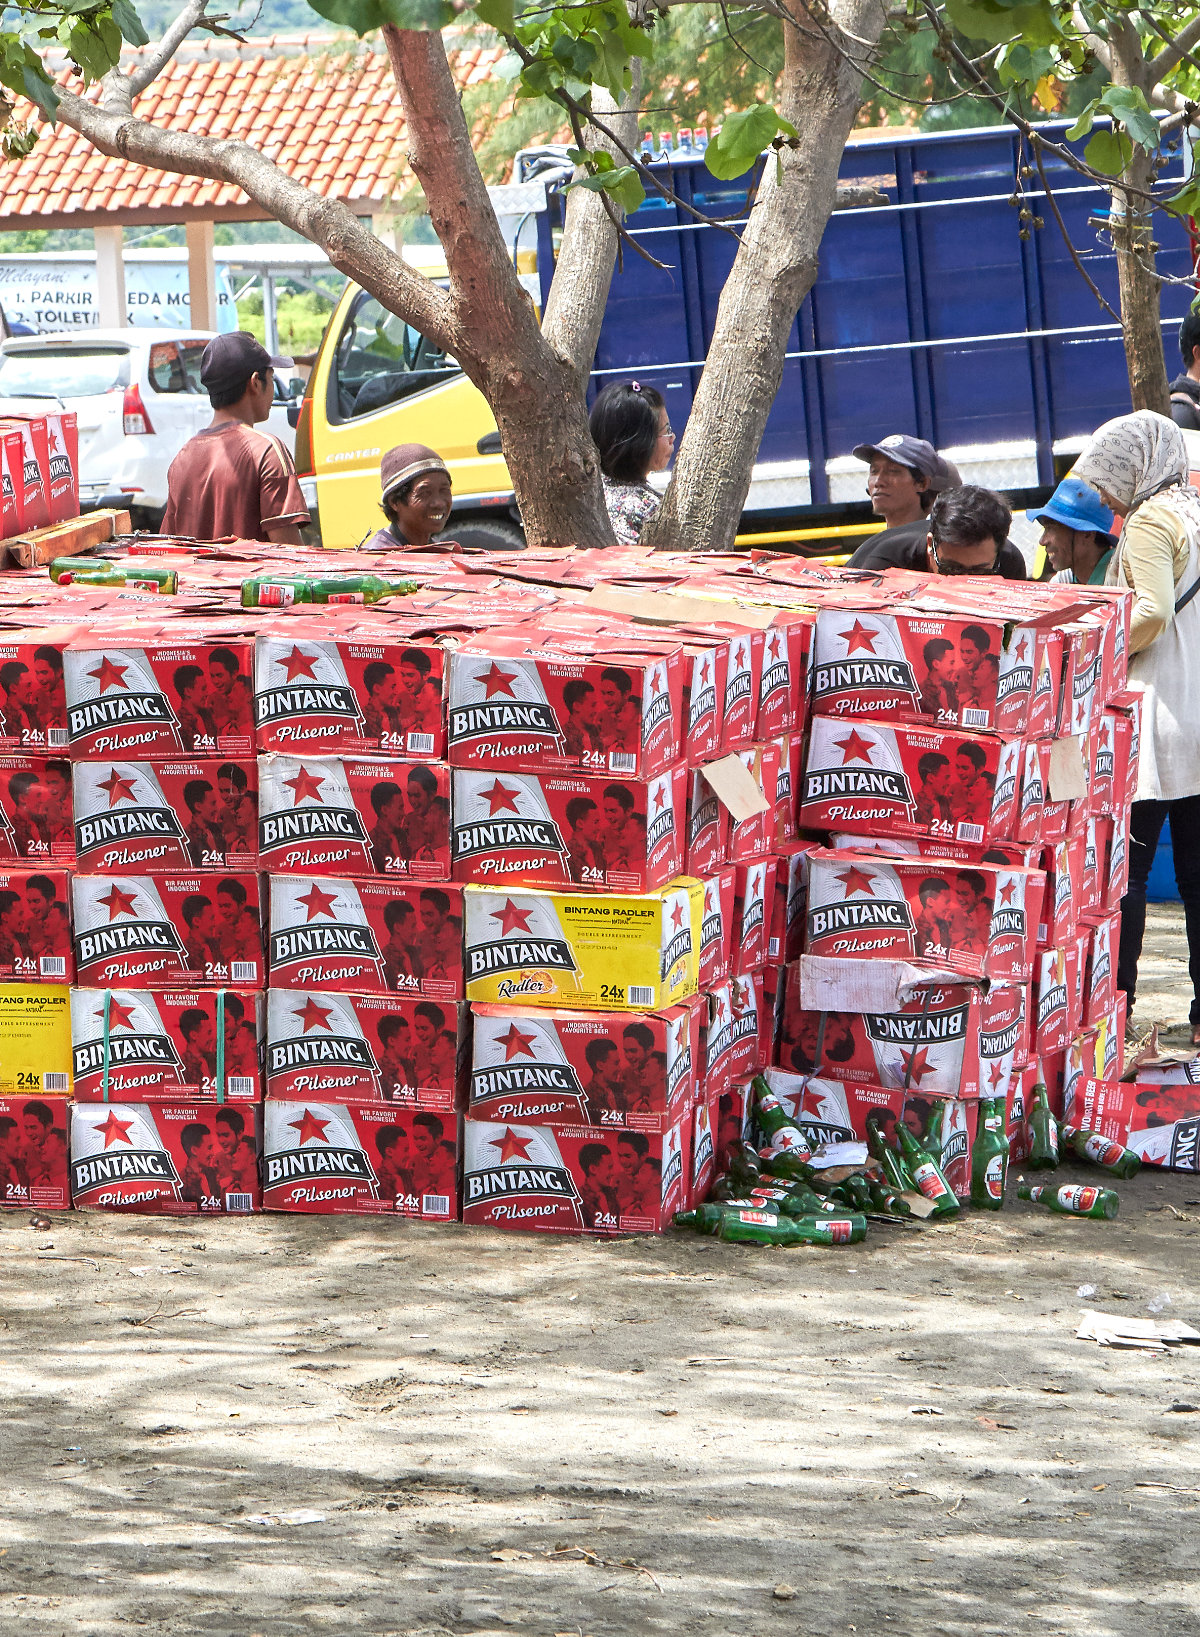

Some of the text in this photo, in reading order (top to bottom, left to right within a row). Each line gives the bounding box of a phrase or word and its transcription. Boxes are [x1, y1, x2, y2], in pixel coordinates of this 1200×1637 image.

[31, 292, 92, 304] PARKIR
[128, 293, 161, 304] EDA
[326, 448, 380, 462] CANTER
[816, 664, 903, 691] BINTANG
[998, 670, 1031, 696] BINTANG
[258, 690, 347, 720] BINTANG
[836, 698, 899, 715] Pilsener
[70, 698, 161, 732] BINTANG
[453, 707, 546, 735] BINTANG
[937, 709, 958, 721] 24x
[22, 730, 44, 742] 24x
[95, 730, 160, 752] Pilsener
[193, 735, 215, 746] 24x
[276, 724, 343, 741] Pilsener
[381, 731, 404, 745] 24x
[477, 742, 543, 760] Pilsener
[582, 751, 606, 764] 24x
[808, 773, 899, 798] BINTANG
[828, 805, 893, 821] Pilsener
[79, 812, 169, 847] BINTANG
[264, 812, 354, 844] BINTANG
[931, 819, 954, 832] 24x
[458, 824, 550, 853] BINTANG
[104, 845, 168, 866] Pilsener
[287, 848, 350, 867] Pilsener
[385, 857, 406, 869] 24x
[480, 857, 546, 874] Pilsener
[565, 907, 654, 917] BINTANG RADLER
[812, 905, 901, 933] BINTANG
[80, 926, 169, 961] BINTANG
[276, 929, 367, 961] BINTANG
[834, 938, 895, 954] Pilsener
[14, 957, 37, 970] 24x
[105, 957, 166, 978] Pilsener
[471, 944, 563, 974] BINTANG
[206, 962, 228, 976] 24x
[298, 964, 363, 983] Pilsener
[397, 974, 418, 987] 24x
[497, 978, 544, 998] Radler
[600, 985, 624, 998] 24x
[1039, 986, 1066, 1024] BINTANG
[272, 1040, 363, 1071] BINTANG
[294, 1073, 359, 1092] Pilsener
[475, 1069, 568, 1098] BINTANG
[857, 1096, 888, 1105] INDONESIA
[866, 1090, 891, 1100] FAVORIT
[499, 1102, 564, 1119] Pilsener
[601, 1110, 623, 1122] 24x
[76, 1154, 164, 1188] BINTANG
[268, 1153, 359, 1181] BINTANG
[6, 1184, 27, 1196] 24x
[469, 1170, 562, 1199] BINTANG
[99, 1189, 167, 1206] Pilsener
[201, 1196, 220, 1207] 24x
[291, 1186, 356, 1203] Pilsener
[492, 1204, 558, 1220] Pilsener
